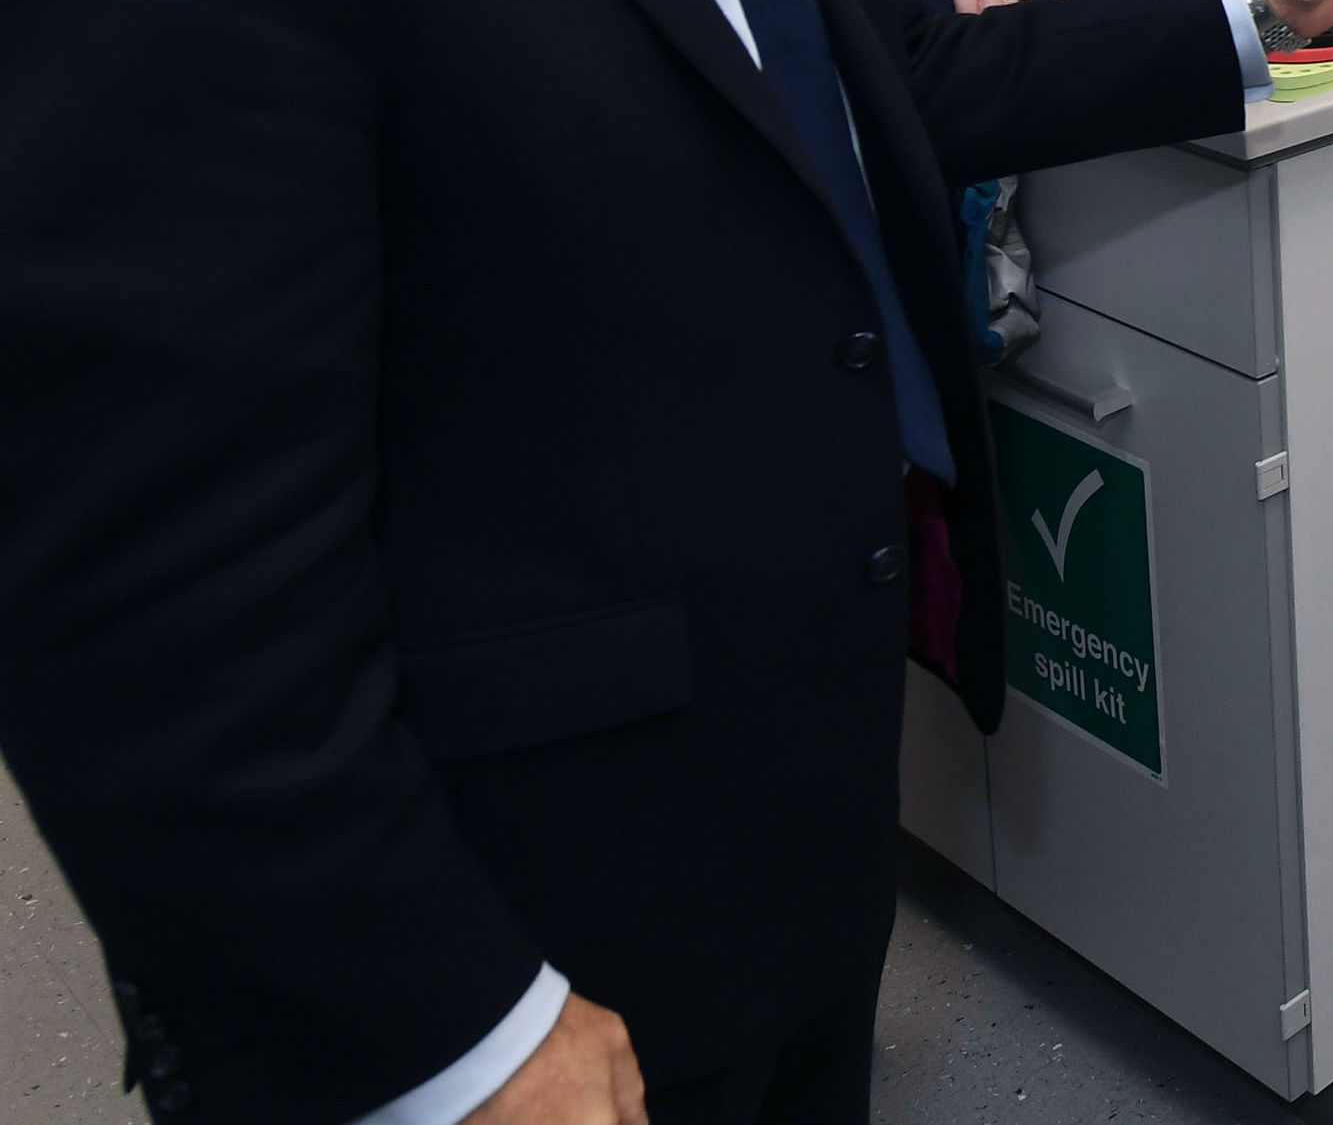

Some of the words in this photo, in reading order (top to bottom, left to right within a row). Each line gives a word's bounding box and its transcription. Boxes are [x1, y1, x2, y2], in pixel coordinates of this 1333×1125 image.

[1006, 579, 1149, 693] Emergency
[1034, 652, 1086, 701] spill
[1094, 678, 1127, 725] kit
